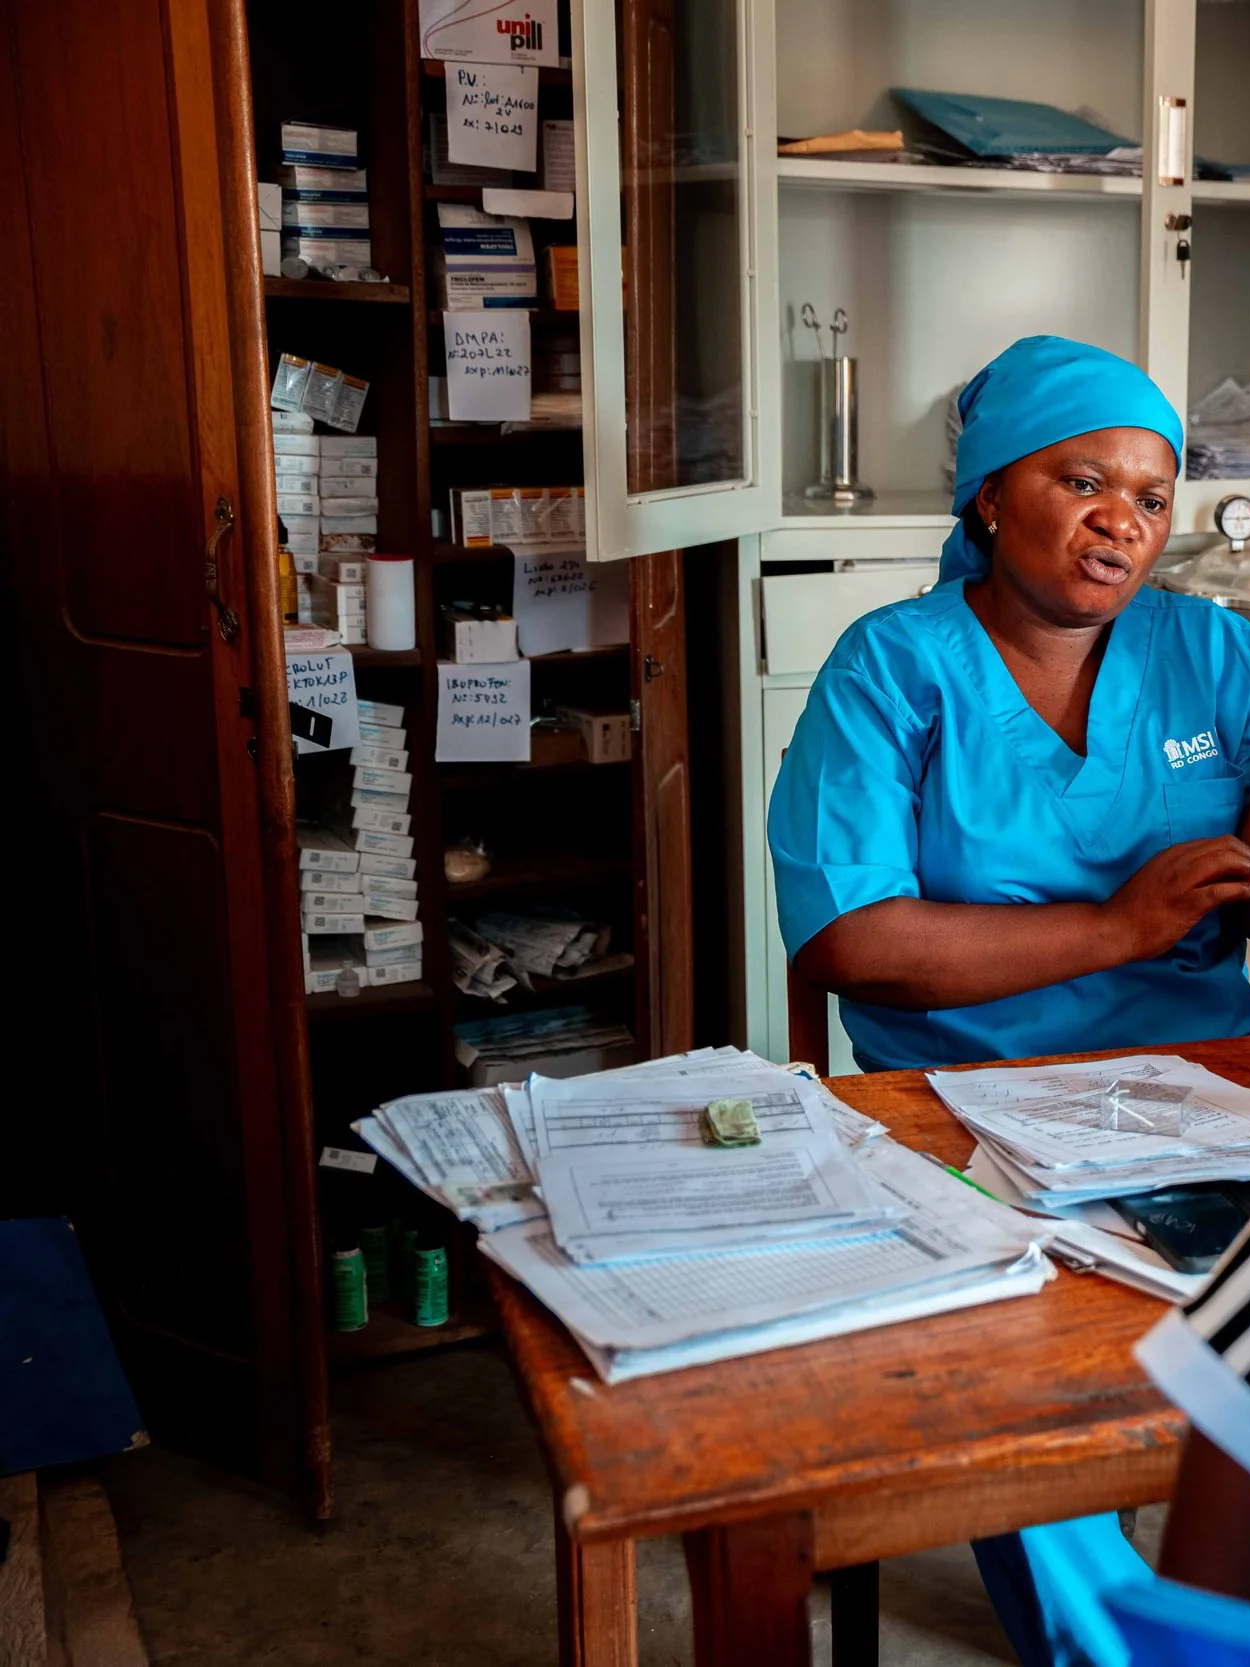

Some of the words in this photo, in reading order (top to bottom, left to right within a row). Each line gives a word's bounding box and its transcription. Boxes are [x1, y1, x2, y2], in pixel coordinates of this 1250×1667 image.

[1181, 731, 1216, 757] MSI
[1170, 760, 1185, 770] RD
[1187, 748, 1219, 765] CONGO
